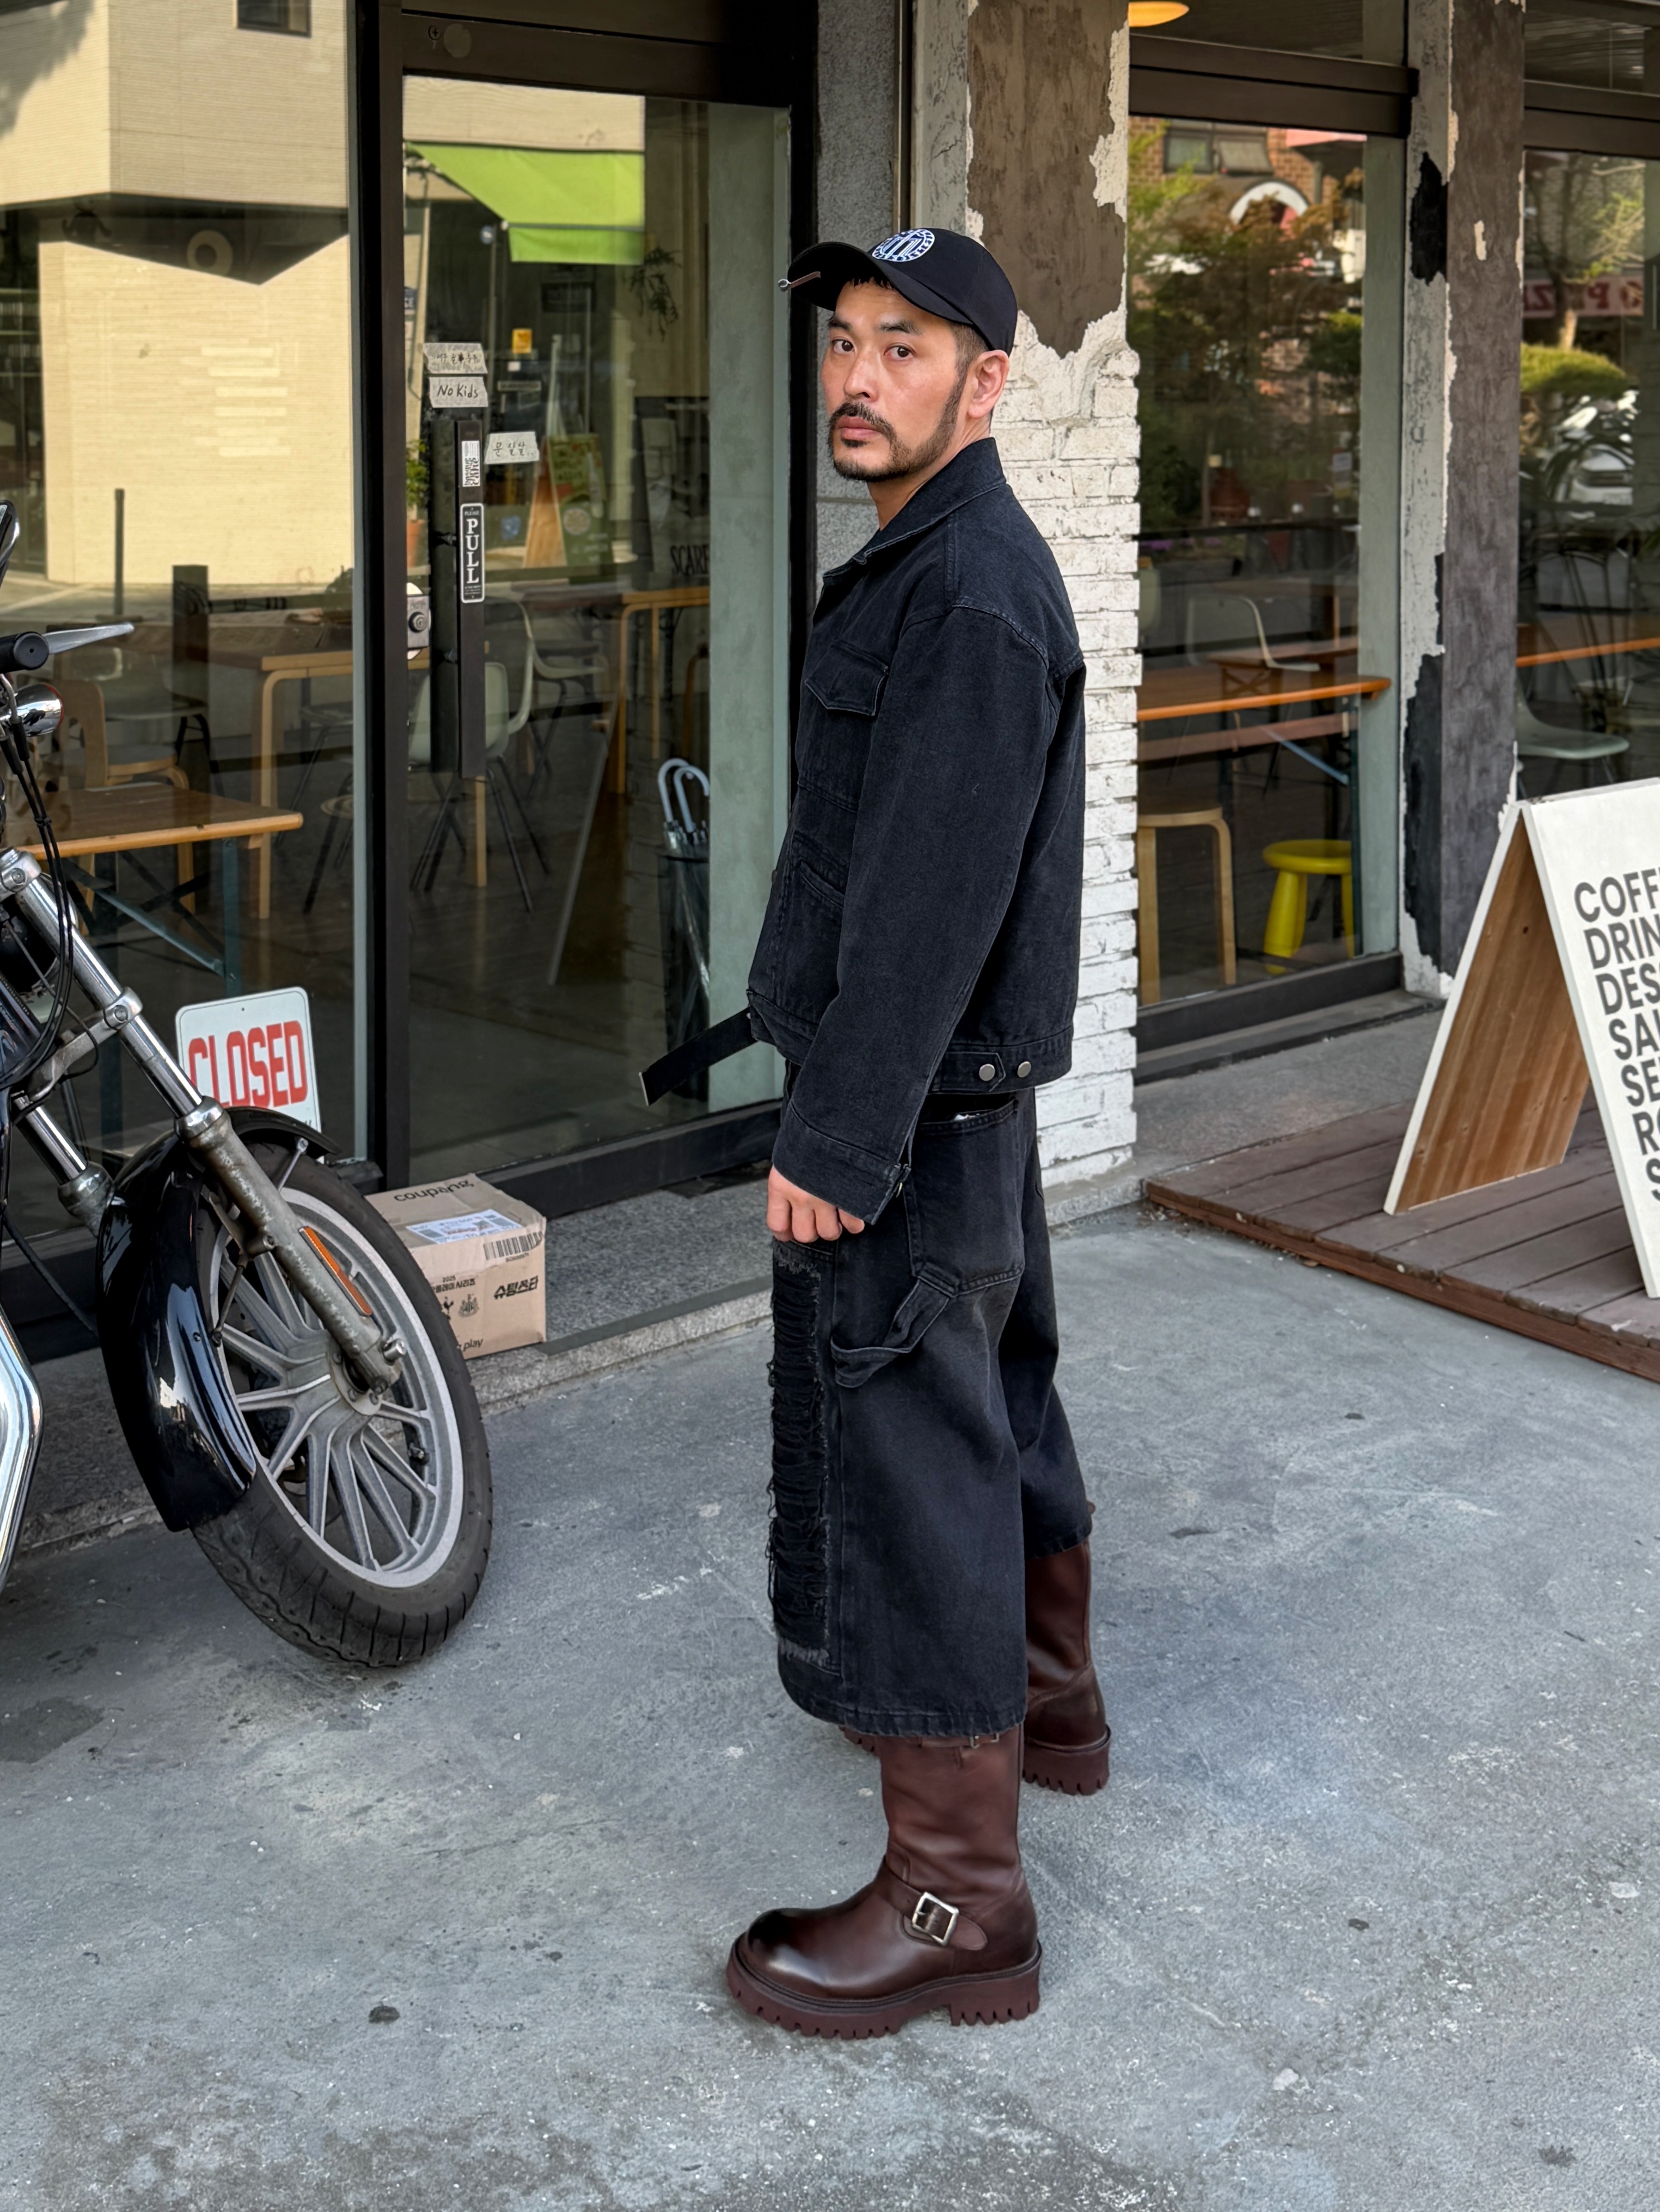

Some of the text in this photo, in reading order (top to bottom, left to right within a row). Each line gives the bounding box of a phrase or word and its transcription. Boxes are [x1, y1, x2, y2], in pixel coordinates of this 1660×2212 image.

[437, 383, 478, 398] No Kids
[493, 442, 503, 457] 문
[465, 518, 480, 584] PULL
[1574, 867, 1660, 923] COFF
[1595, 961, 1660, 1015] DES
[188, 1020, 308, 1109] CLOSED
[1620, 1056, 1660, 1107] SE
[394, 1180, 474, 1202] coupang
[463, 1338, 483, 1352] play
